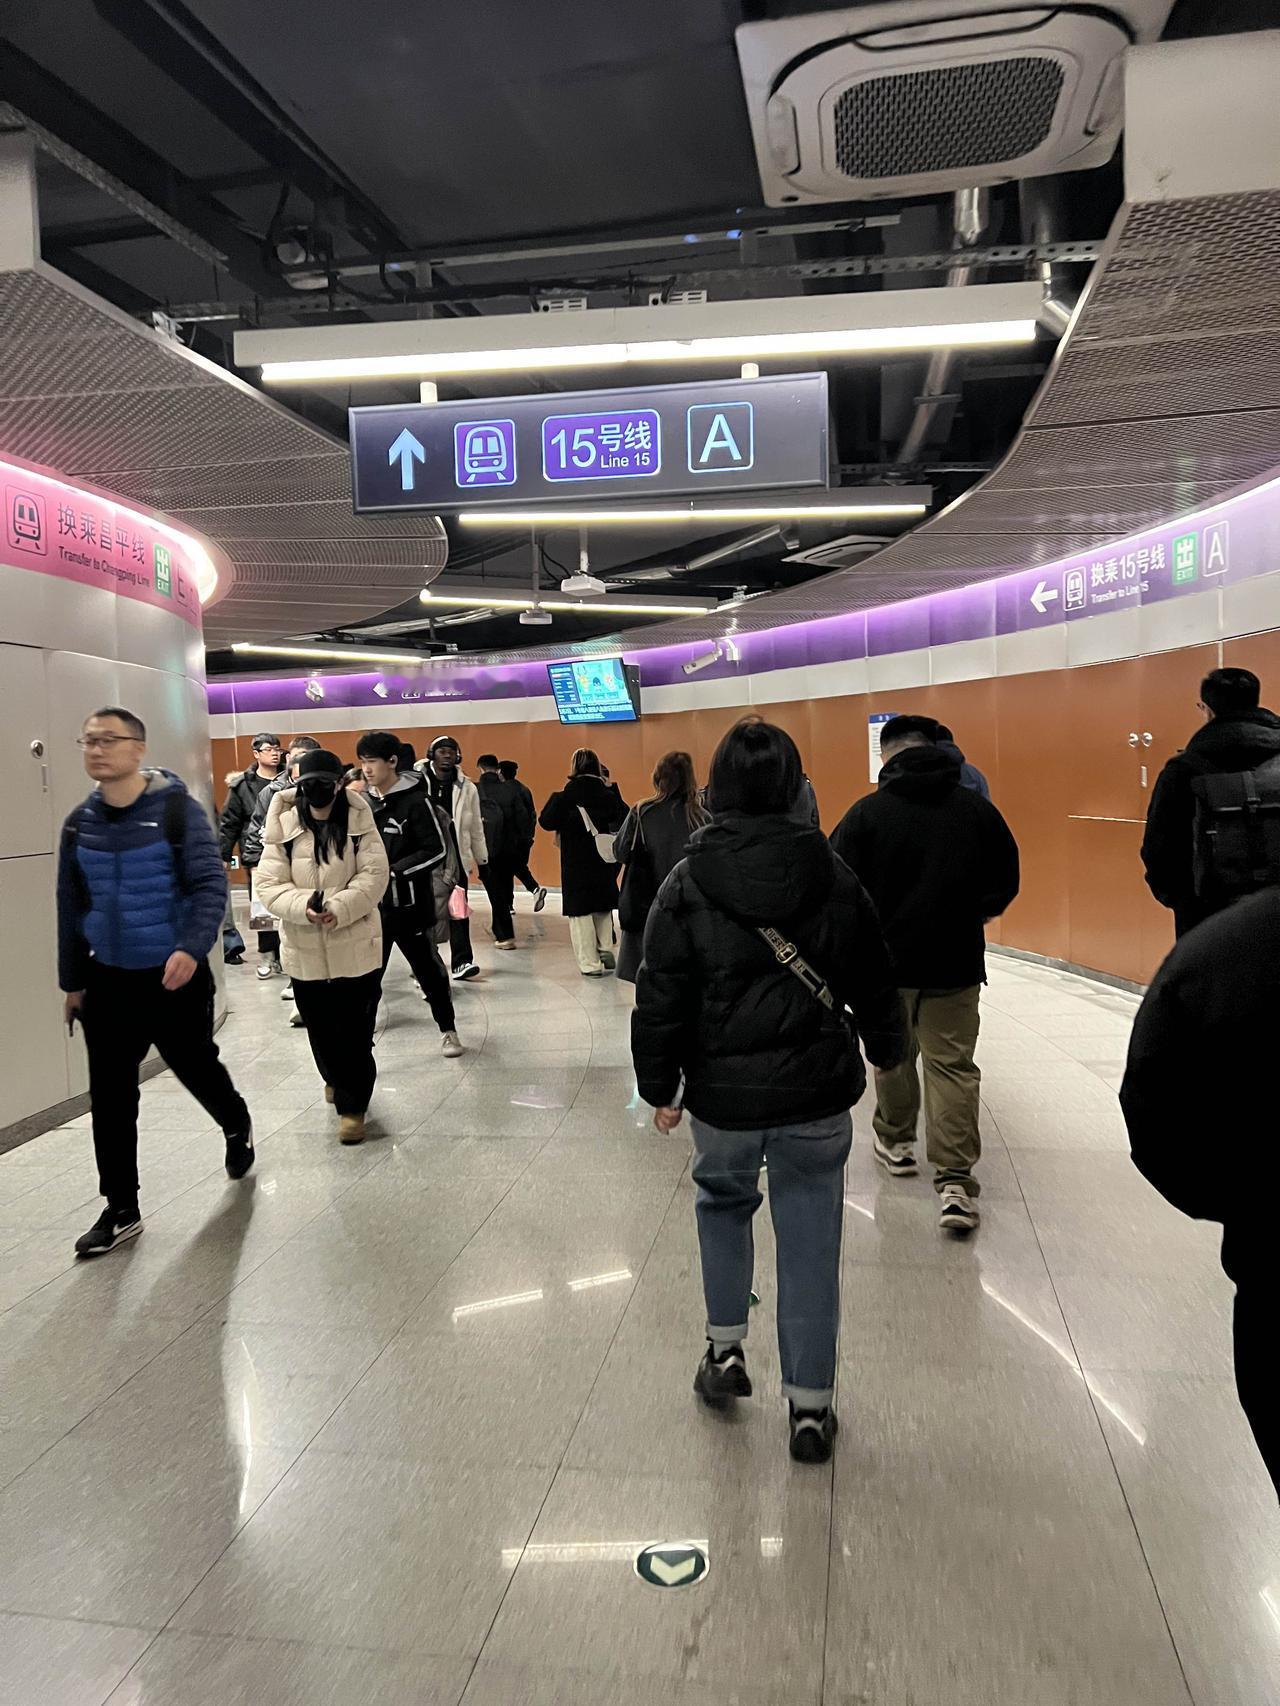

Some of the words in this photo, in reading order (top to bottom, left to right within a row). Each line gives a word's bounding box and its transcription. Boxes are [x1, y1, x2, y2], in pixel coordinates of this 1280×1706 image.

[551, 420, 651, 469] 15号线
[700, 413, 742, 463] A
[600, 454, 629, 469] Line
[634, 452, 650, 466] 15
[58, 503, 145, 565] 换乘昌平线
[1207, 531, 1225, 569] A
[59, 546, 92, 567] Transfer
[93, 558, 100, 570] to
[156, 548, 169, 583] 出
[1091, 543, 1166, 588] 换乘15号线
[1176, 538, 1194, 569] 出
[1176, 567, 1194, 581] EXIT
[1091, 590, 1117, 603] Transfer
[1125, 584, 1140, 596] Line
